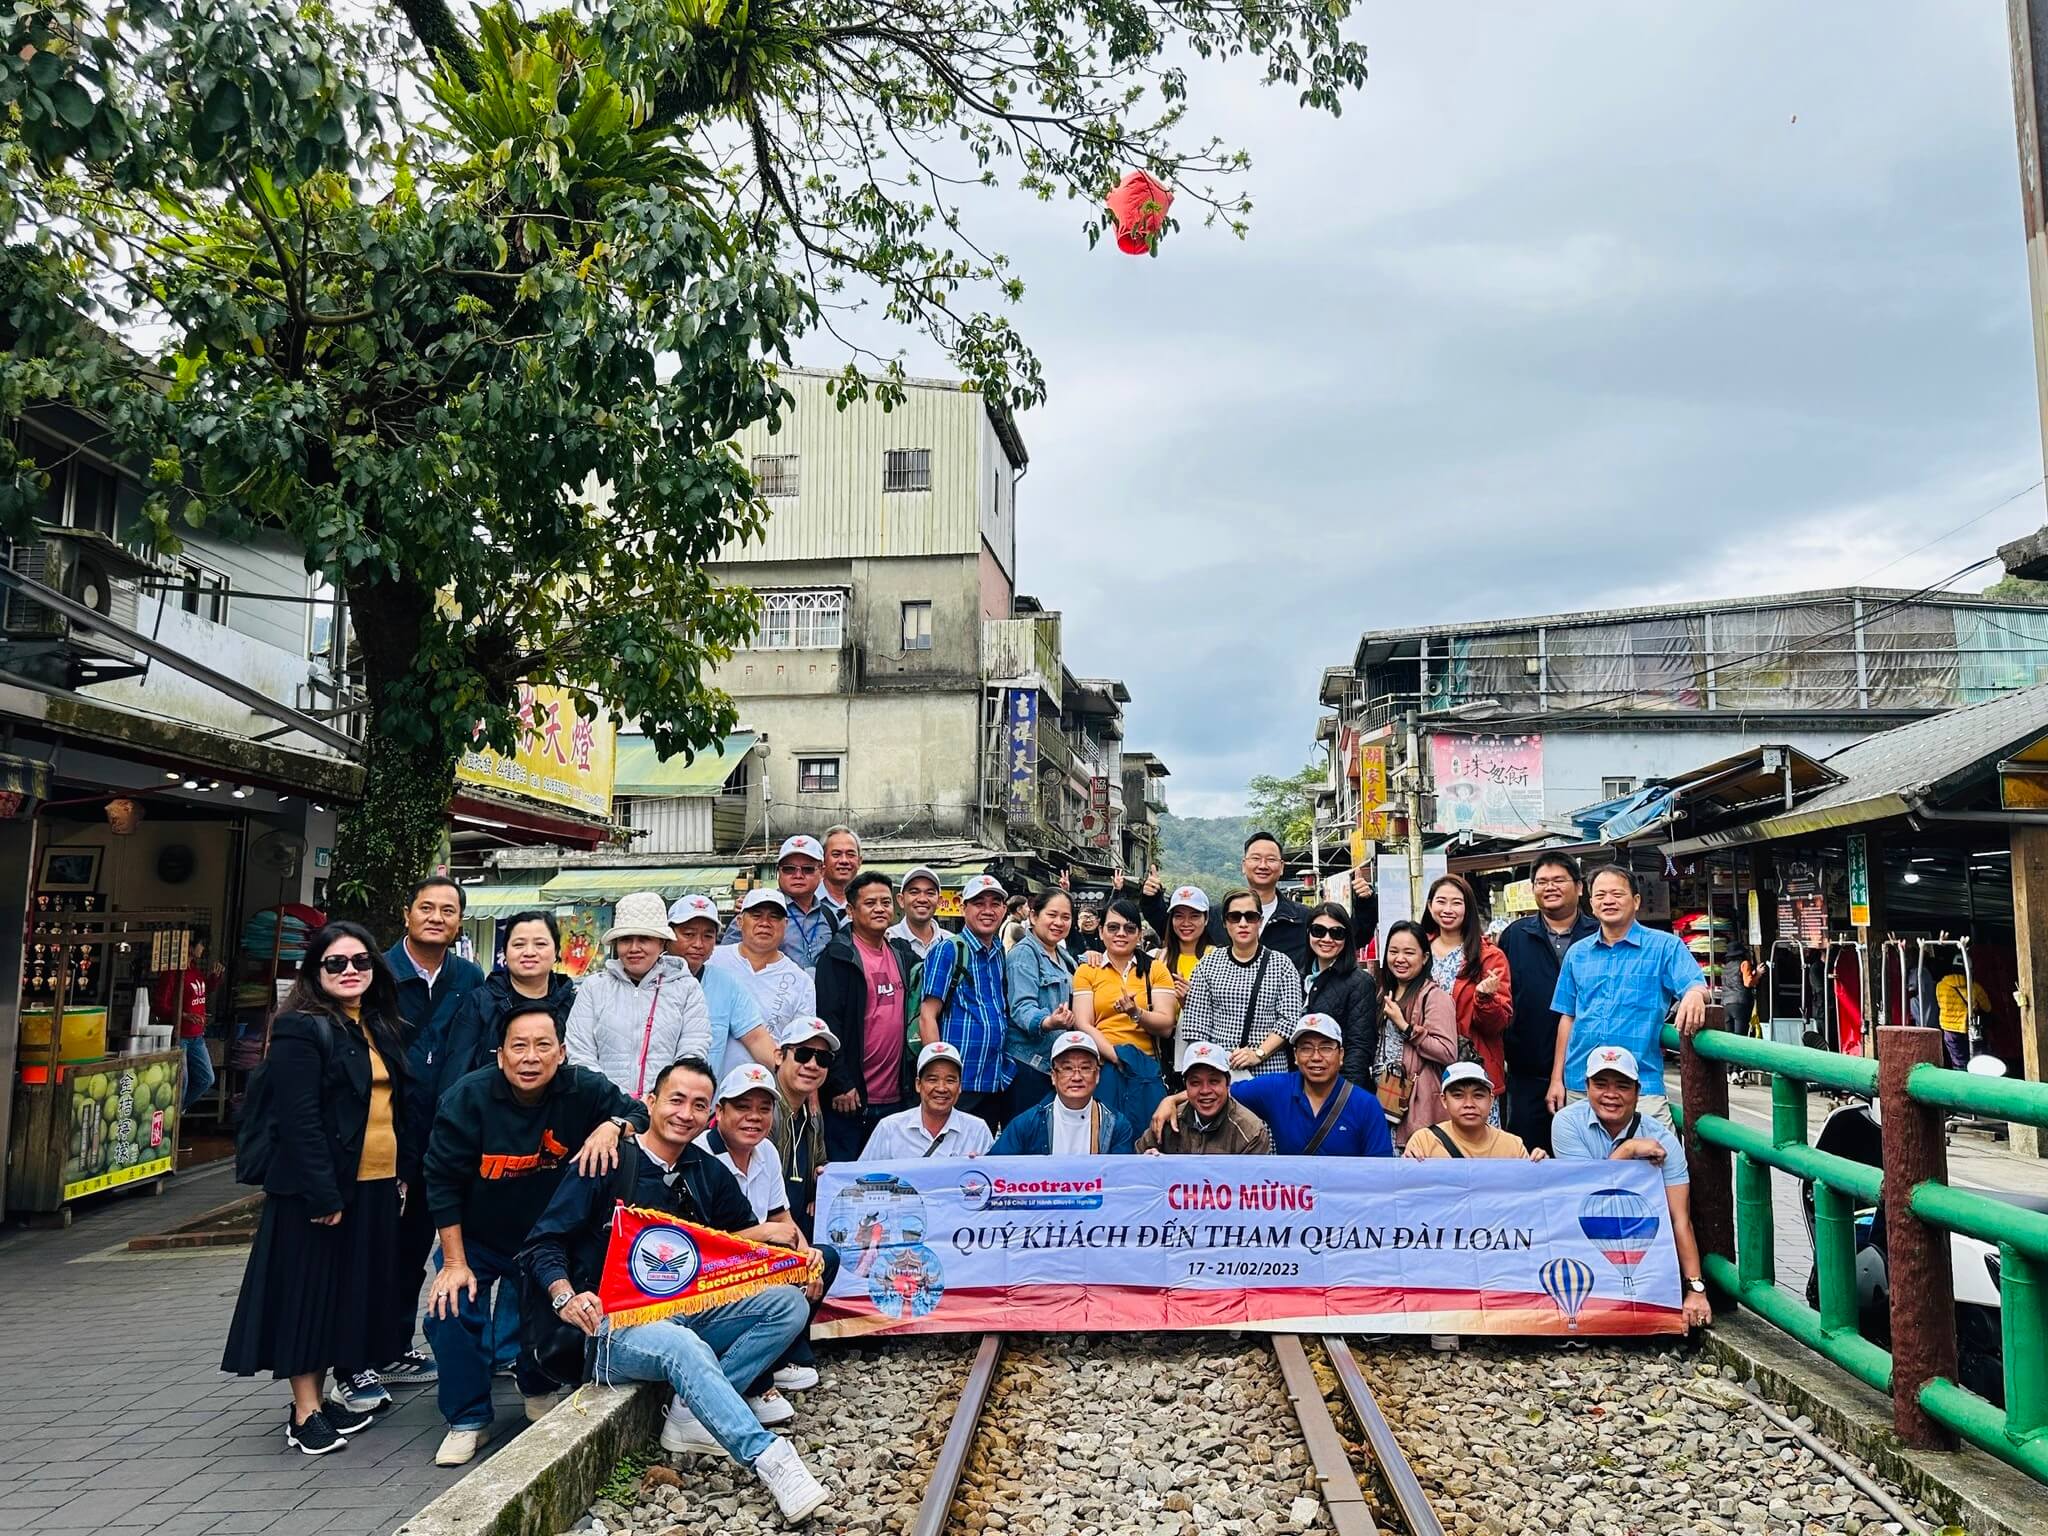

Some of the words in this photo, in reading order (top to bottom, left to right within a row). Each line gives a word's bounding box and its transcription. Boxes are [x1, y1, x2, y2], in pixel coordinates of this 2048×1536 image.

[993, 1177, 1102, 1194] Sacotravel
[1168, 1179, 1232, 1211] CHÀO
[1240, 1179, 1314, 1211] MỪNG
[952, 1221, 1020, 1256] QUÝ
[1020, 1220, 1130, 1250] KHÁCH
[1137, 1218, 1200, 1249] ĐẾN
[1204, 1225, 1293, 1250] THAM
[1300, 1226, 1386, 1255] QUAN
[1392, 1222, 1445, 1250] ĐÀI
[1453, 1227, 1534, 1251] LOAN
[697, 1256, 800, 1292] Sacotravel.com
[1189, 1262, 1205, 1276] 17
[1216, 1262, 1299, 1276] 21/02/2023
